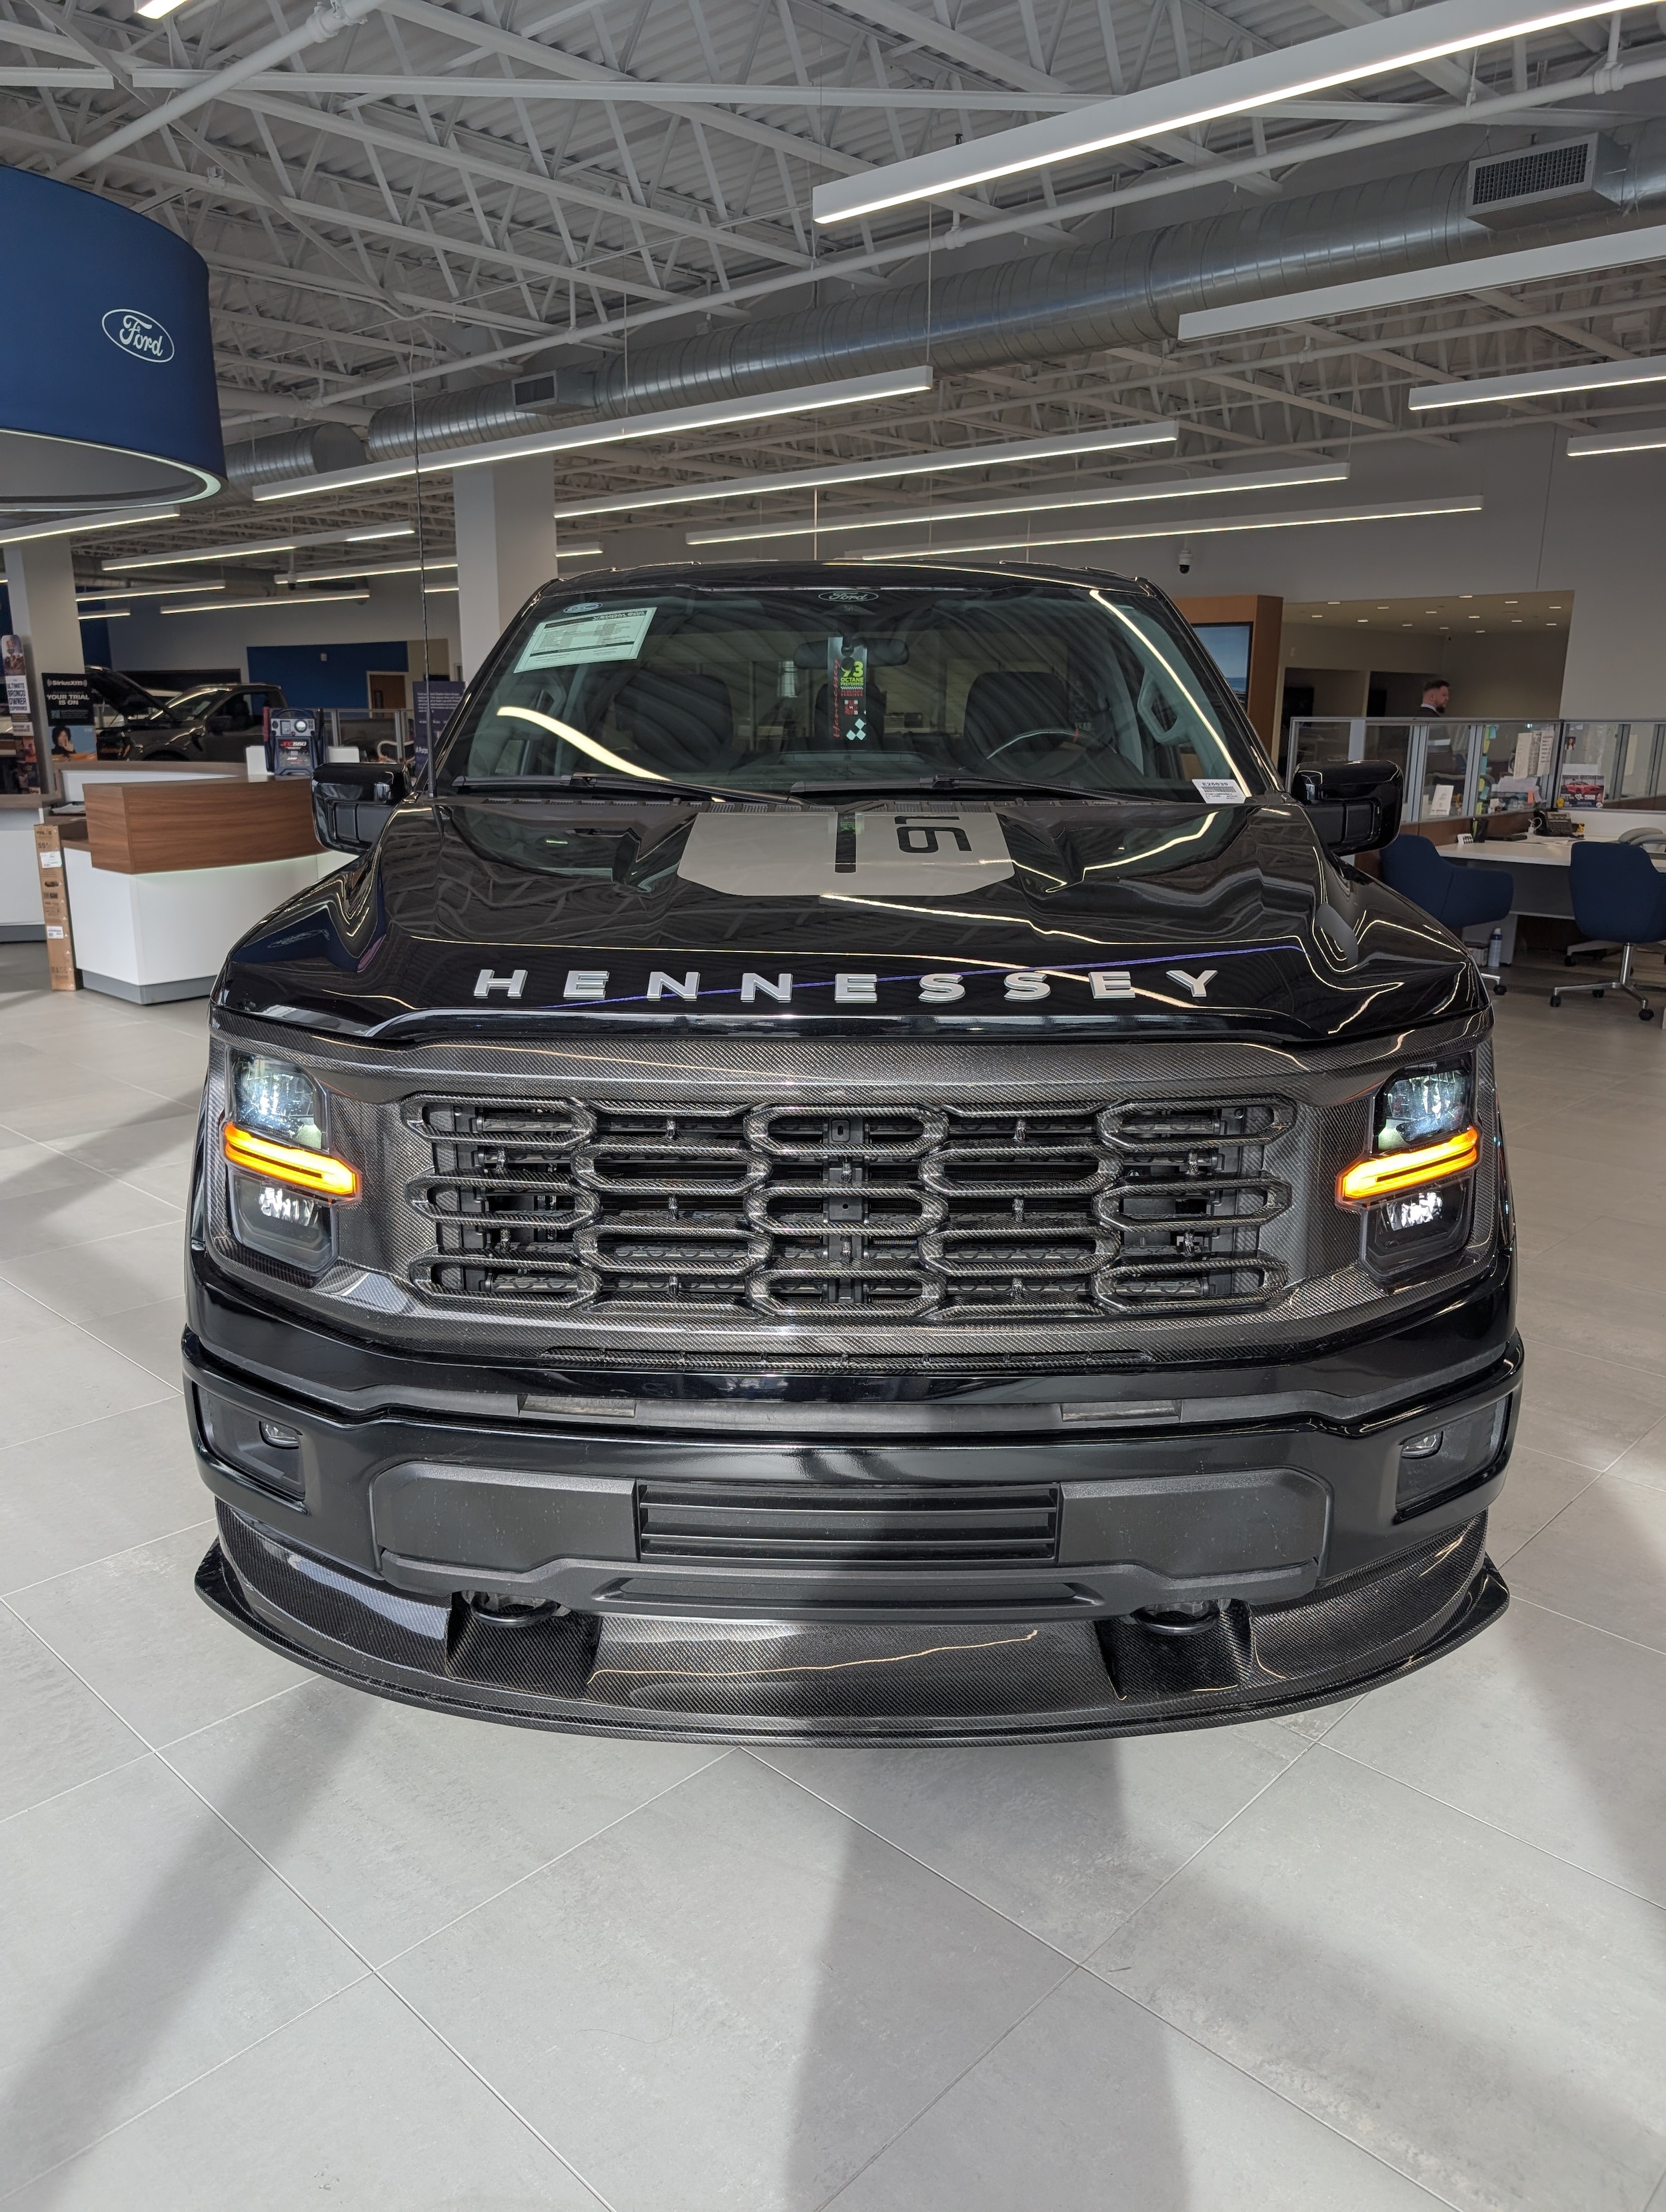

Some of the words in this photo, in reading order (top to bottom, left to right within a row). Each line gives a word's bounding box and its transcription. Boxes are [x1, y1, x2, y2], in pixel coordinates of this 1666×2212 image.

[119, 314, 163, 356] Ford
[828, 592, 868, 600] Ford
[474, 969, 1218, 1002] HENNESSEY
